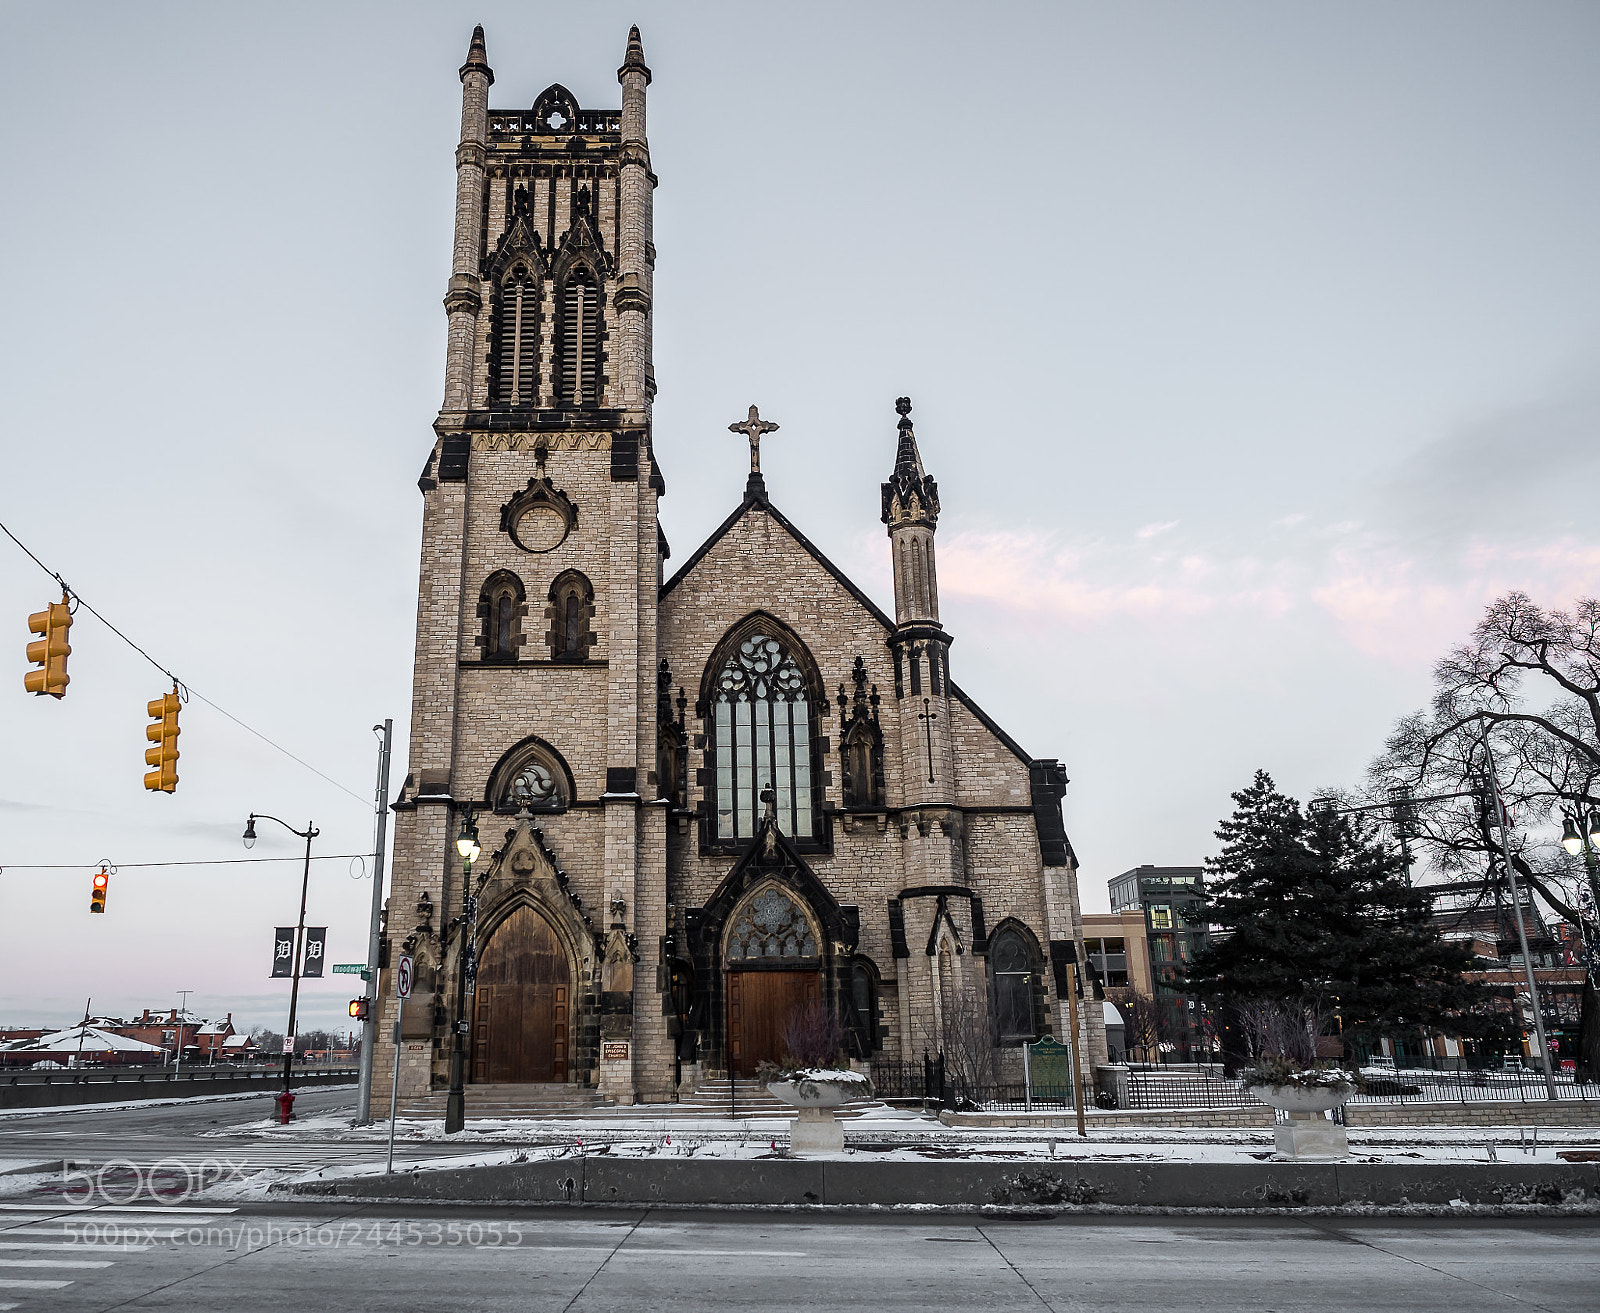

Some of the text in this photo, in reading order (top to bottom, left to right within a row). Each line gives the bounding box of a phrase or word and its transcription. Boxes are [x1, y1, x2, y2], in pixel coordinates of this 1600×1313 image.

[275, 939, 291, 960] D
[306, 939, 322, 960] D
[334, 965, 366, 973] Woodward
